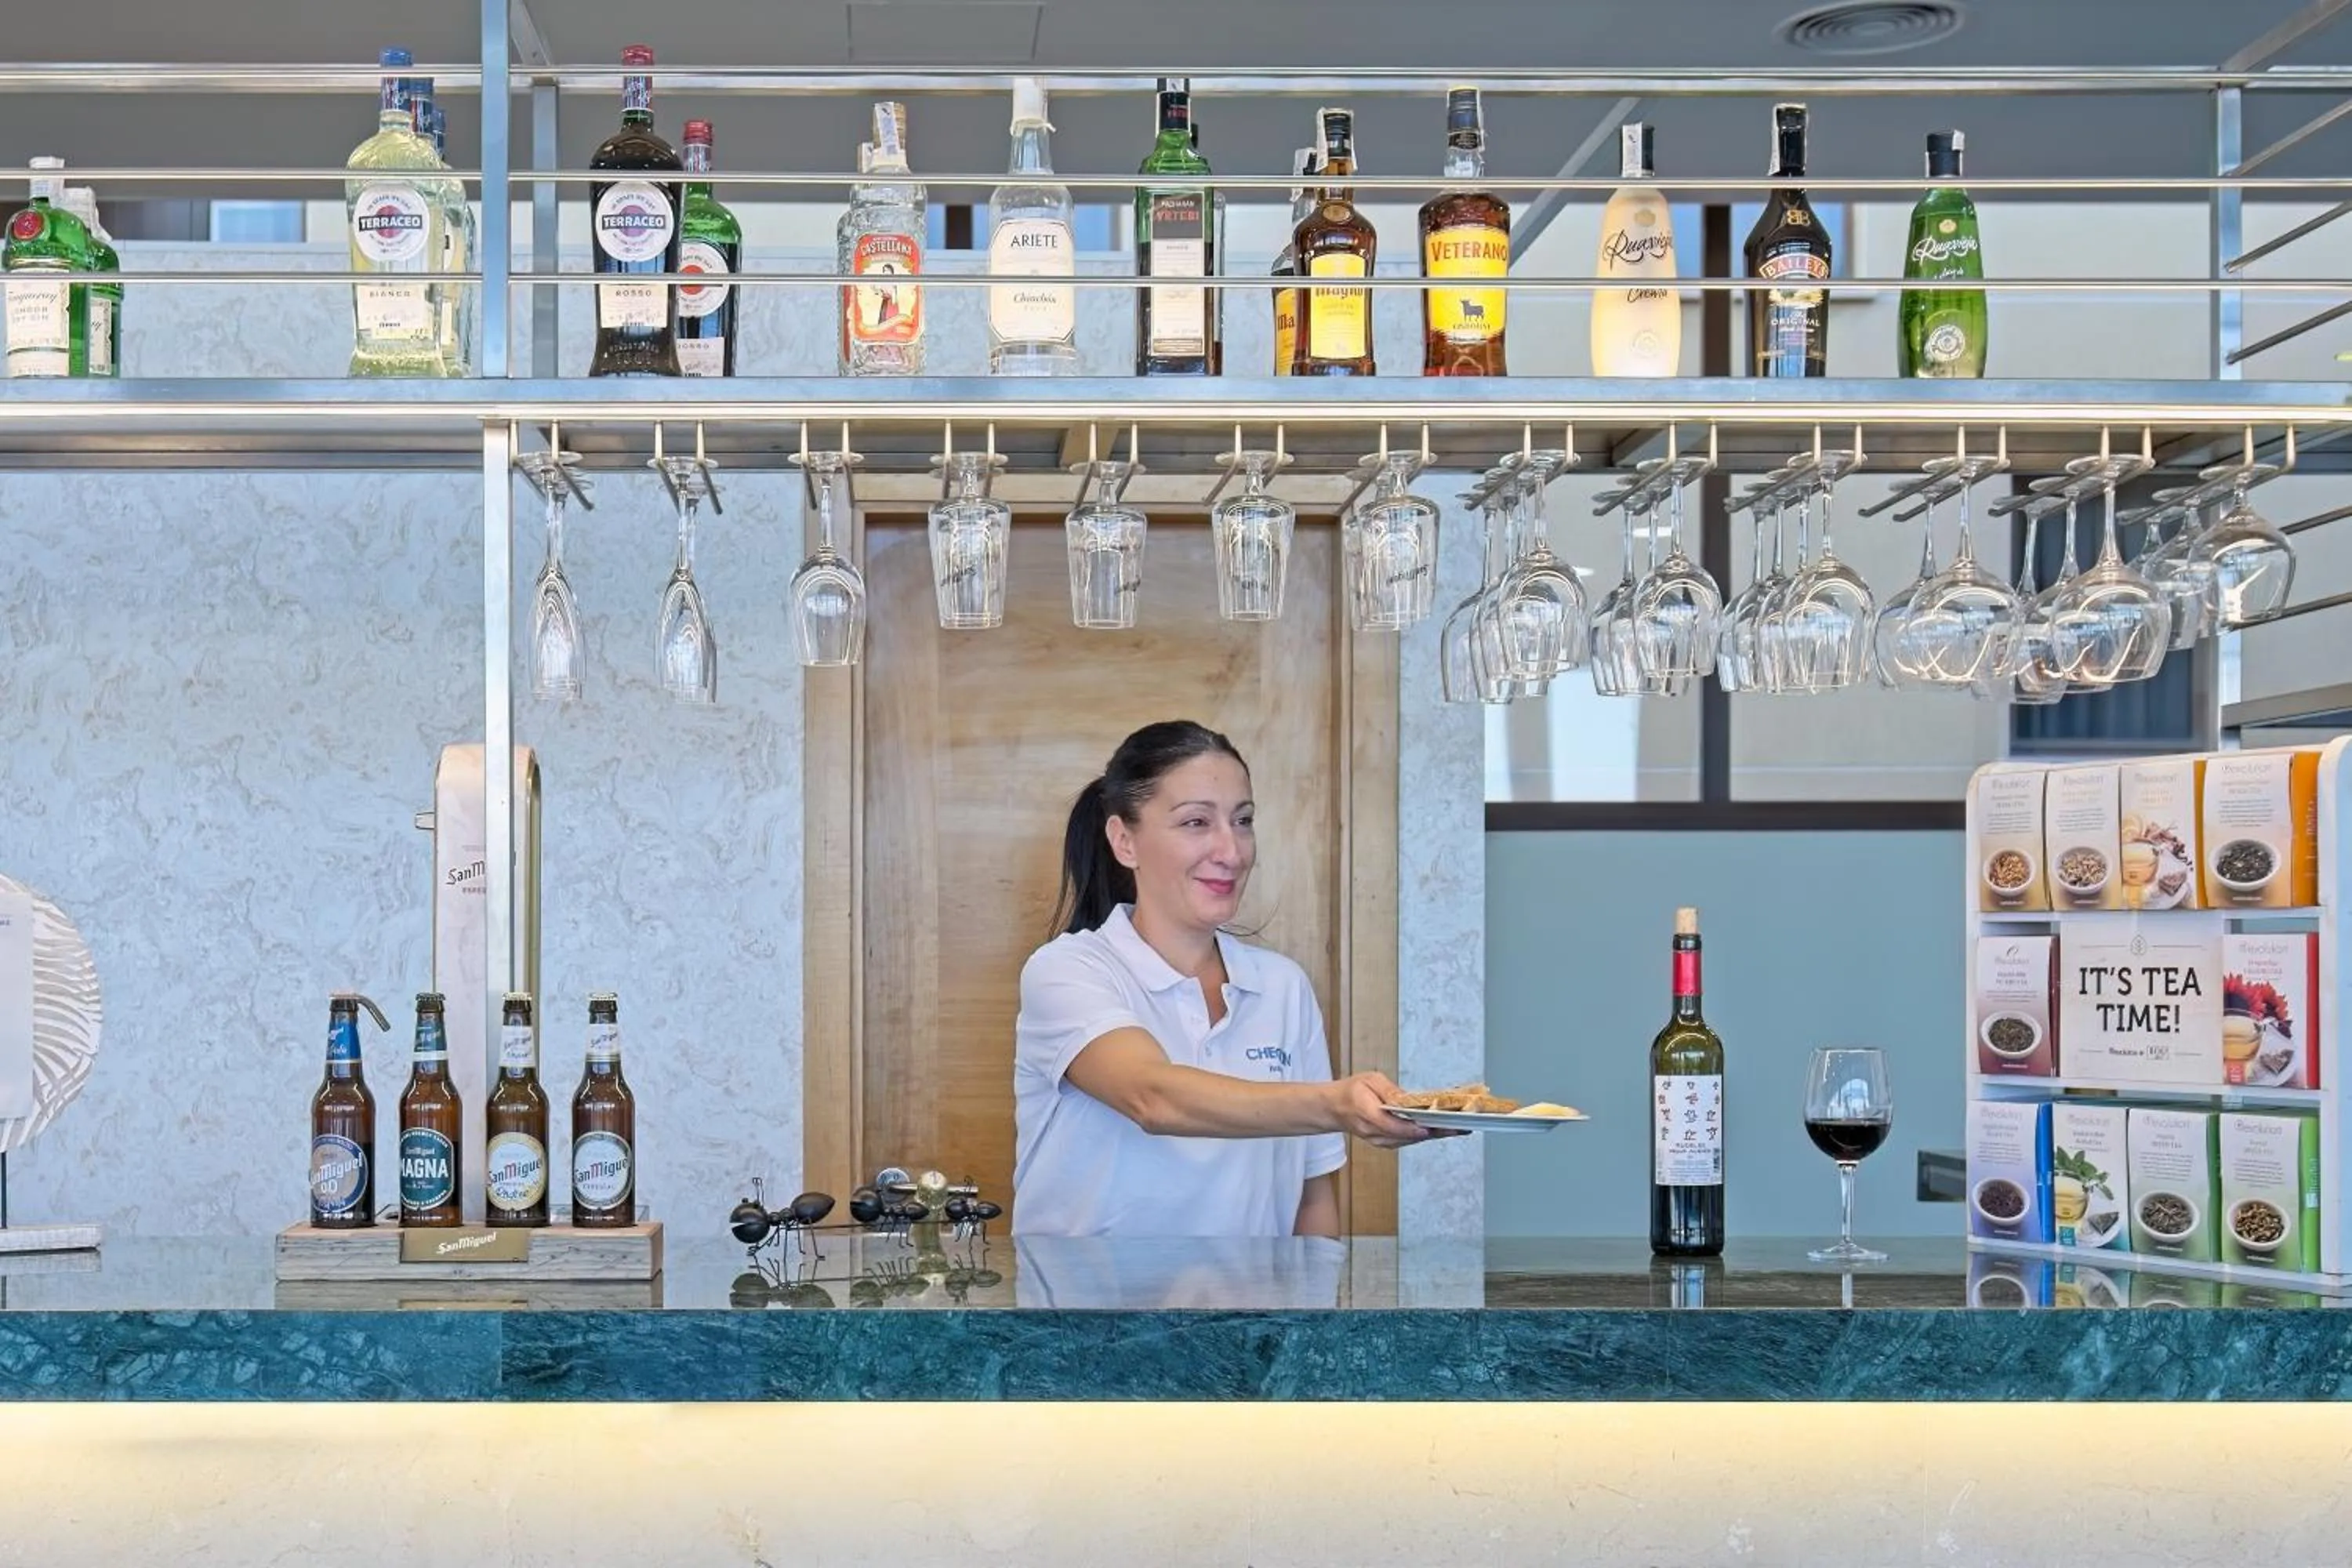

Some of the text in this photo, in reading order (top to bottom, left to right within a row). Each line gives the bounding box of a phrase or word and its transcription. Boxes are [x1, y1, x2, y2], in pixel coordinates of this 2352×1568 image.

[361, 216, 421, 229] TERRACEO
[603, 216, 664, 228] TERRACEO
[1011, 234, 1058, 248] ARIETE
[1432, 240, 1508, 262] VETERANO
[1764, 257, 1827, 278] BAILEYS
[2079, 967, 2202, 996] IT'S TEA
[2096, 1004, 2180, 1033] TIME!
[436, 1231, 498, 1255] SanMiguel
